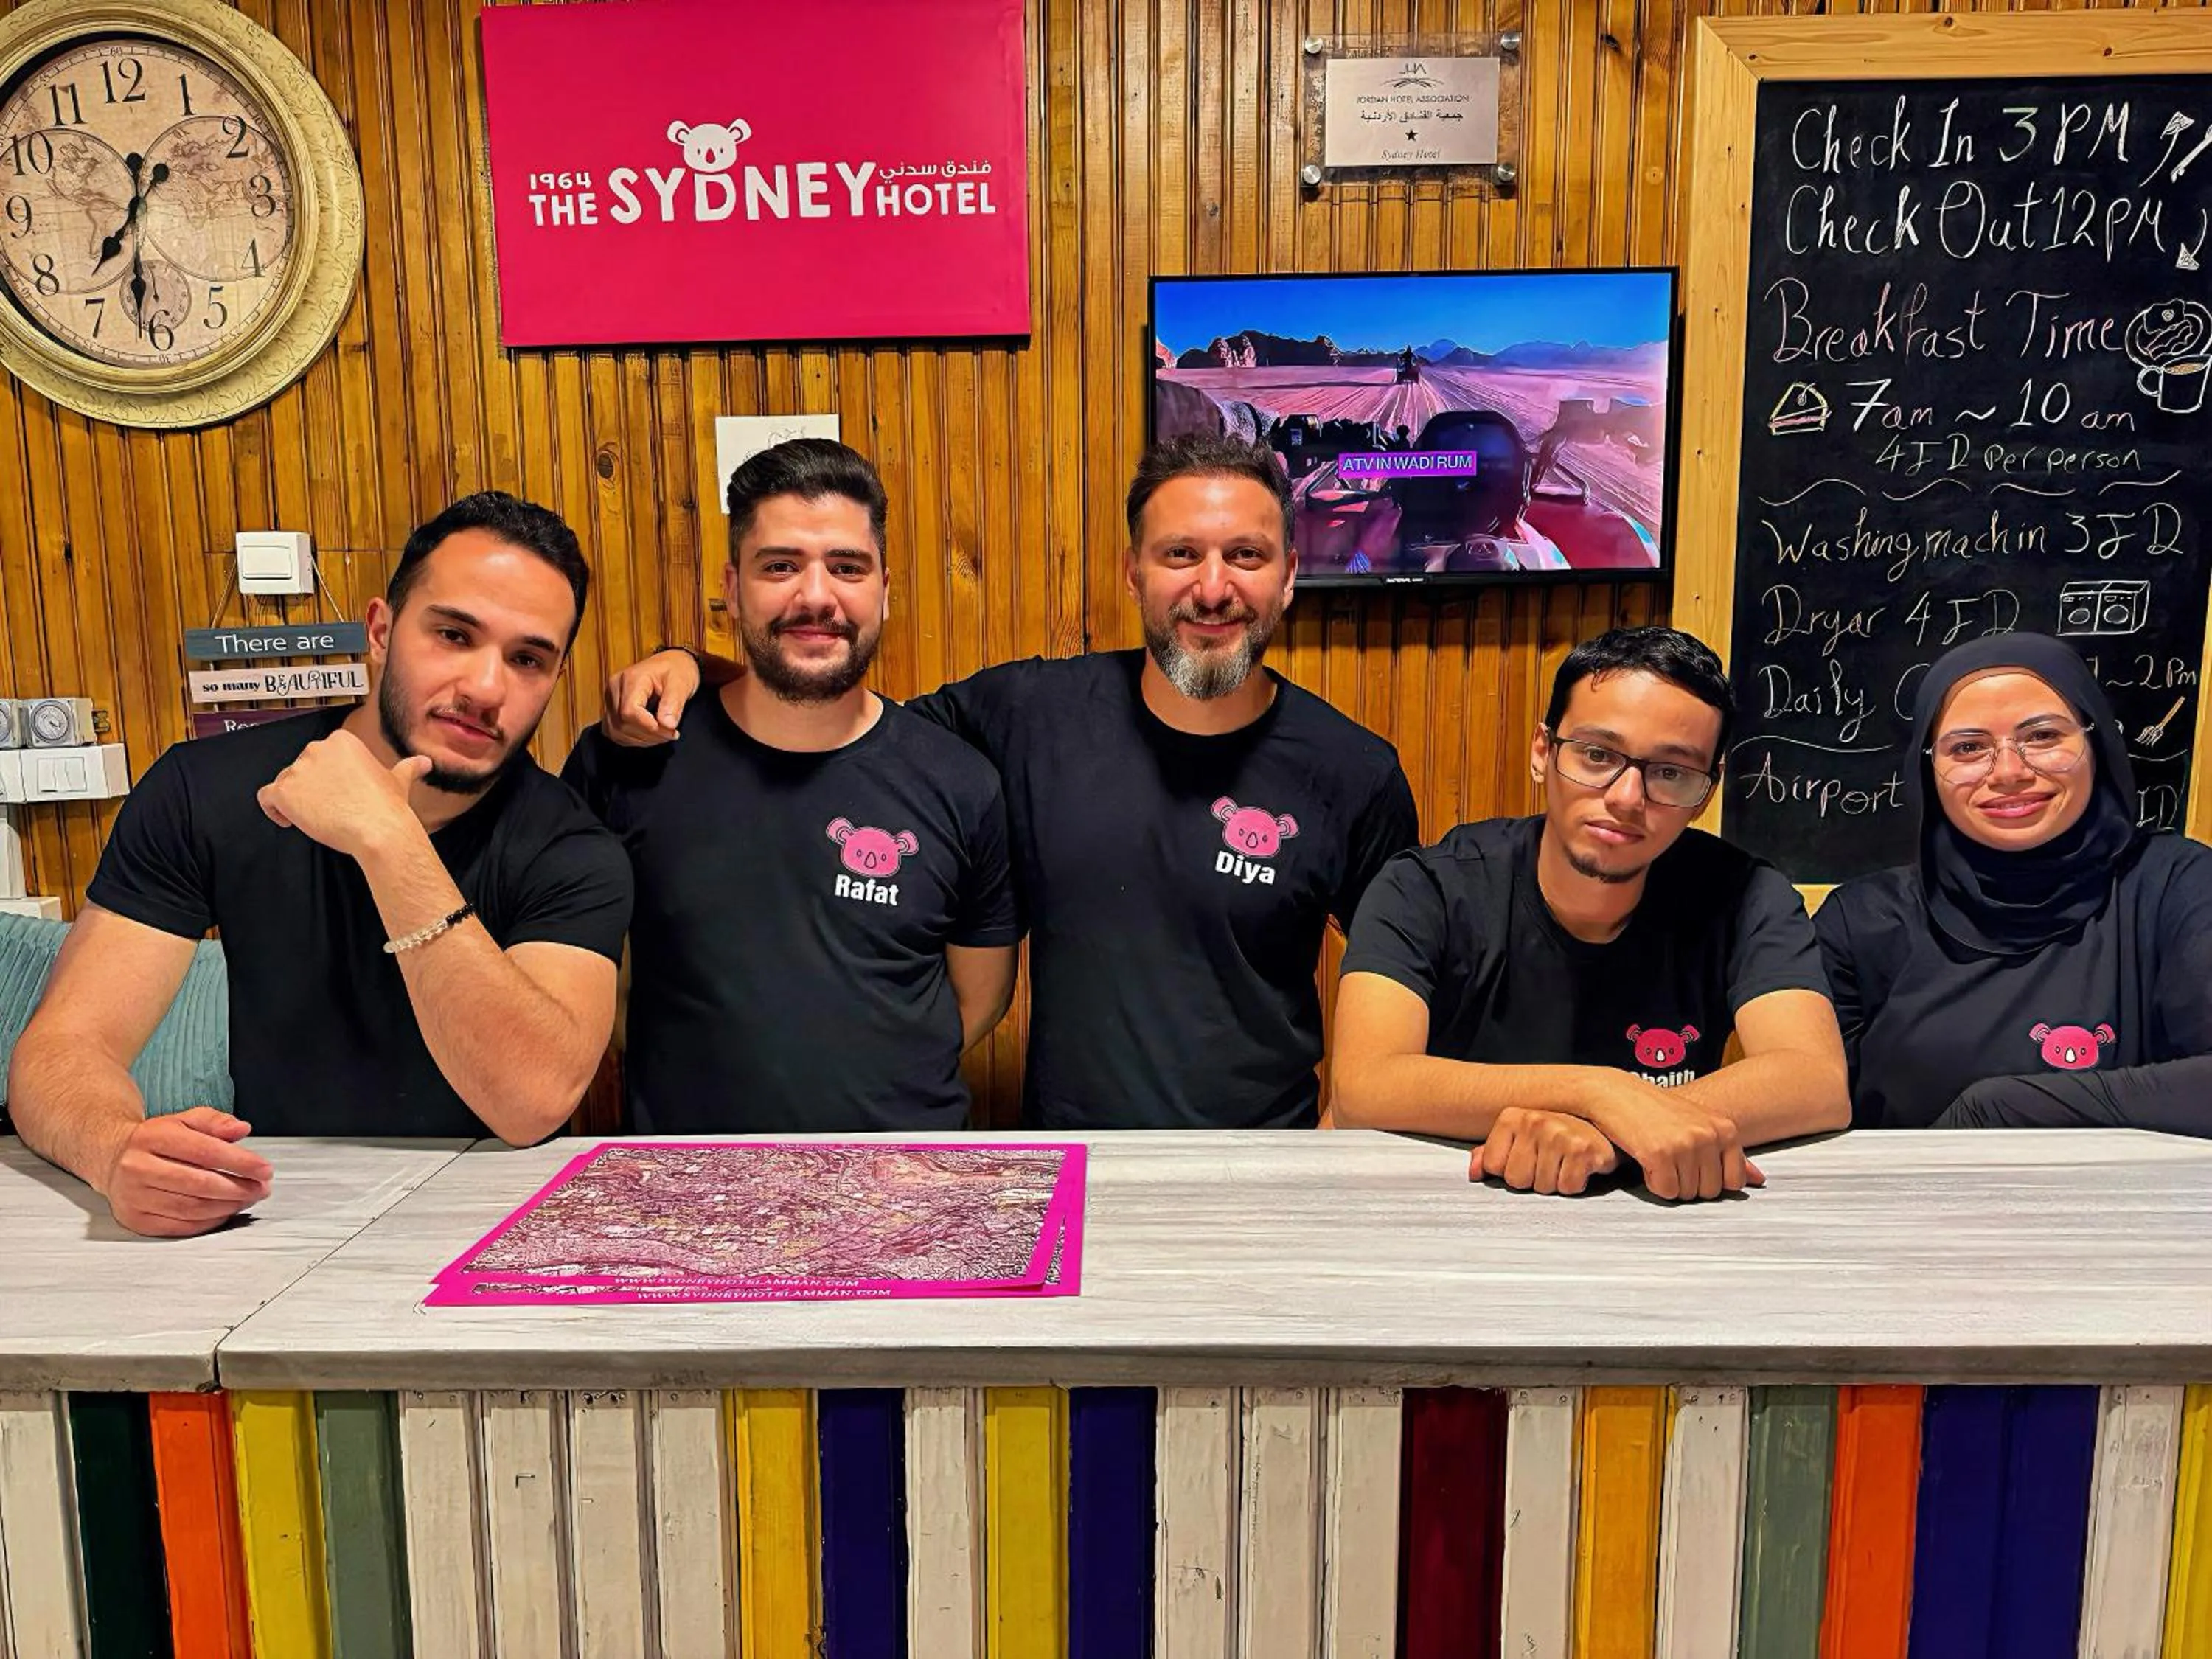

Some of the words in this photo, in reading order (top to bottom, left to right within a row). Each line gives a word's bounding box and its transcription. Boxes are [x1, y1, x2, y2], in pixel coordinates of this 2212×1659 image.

[100, 58, 145, 104] 12
[178, 73, 196, 116] 1
[45, 82, 88, 127] 11
[10, 130, 54, 175] 10
[222, 115, 250, 159] 2
[1415, 148, 1441, 159] Hotel
[1792, 95, 1912, 173] Check
[1927, 97, 1974, 168] In
[1998, 106, 2039, 162] 3
[529, 172, 592, 189] 1964
[879, 161, 938, 184] سدني
[941, 160, 992, 178] فندق
[248, 175, 276, 218] 3
[529, 193, 598, 226] THE
[608, 161, 877, 224] SYDNEY
[876, 182, 996, 218] HOTEL
[6, 195, 32, 239] 9
[1785, 184, 1921, 254] Check
[32, 254, 60, 296] 8
[240, 238, 265, 278] 4
[84, 297, 105, 338] 7
[203, 285, 228, 330] 5
[1764, 277, 1986, 364] Breakfast
[2006, 290, 2125, 359] Time
[147, 308, 174, 352] 6
[1343, 458, 1374, 471] ATV
[1377, 457, 1391, 470] IN
[1394, 456, 1433, 470] WADI
[1437, 455, 1472, 468] RUM
[1761, 507, 1919, 582] Washing
[215, 633, 288, 654] There
[296, 635, 335, 650] are
[223, 681, 260, 692] many
[265, 669, 364, 697] BEAUTIFUL
[1757, 658, 1877, 742] Daily
[1738, 751, 1905, 818] Airport
[1215, 850, 1276, 885] Diya
[834, 874, 900, 906] Rafat
